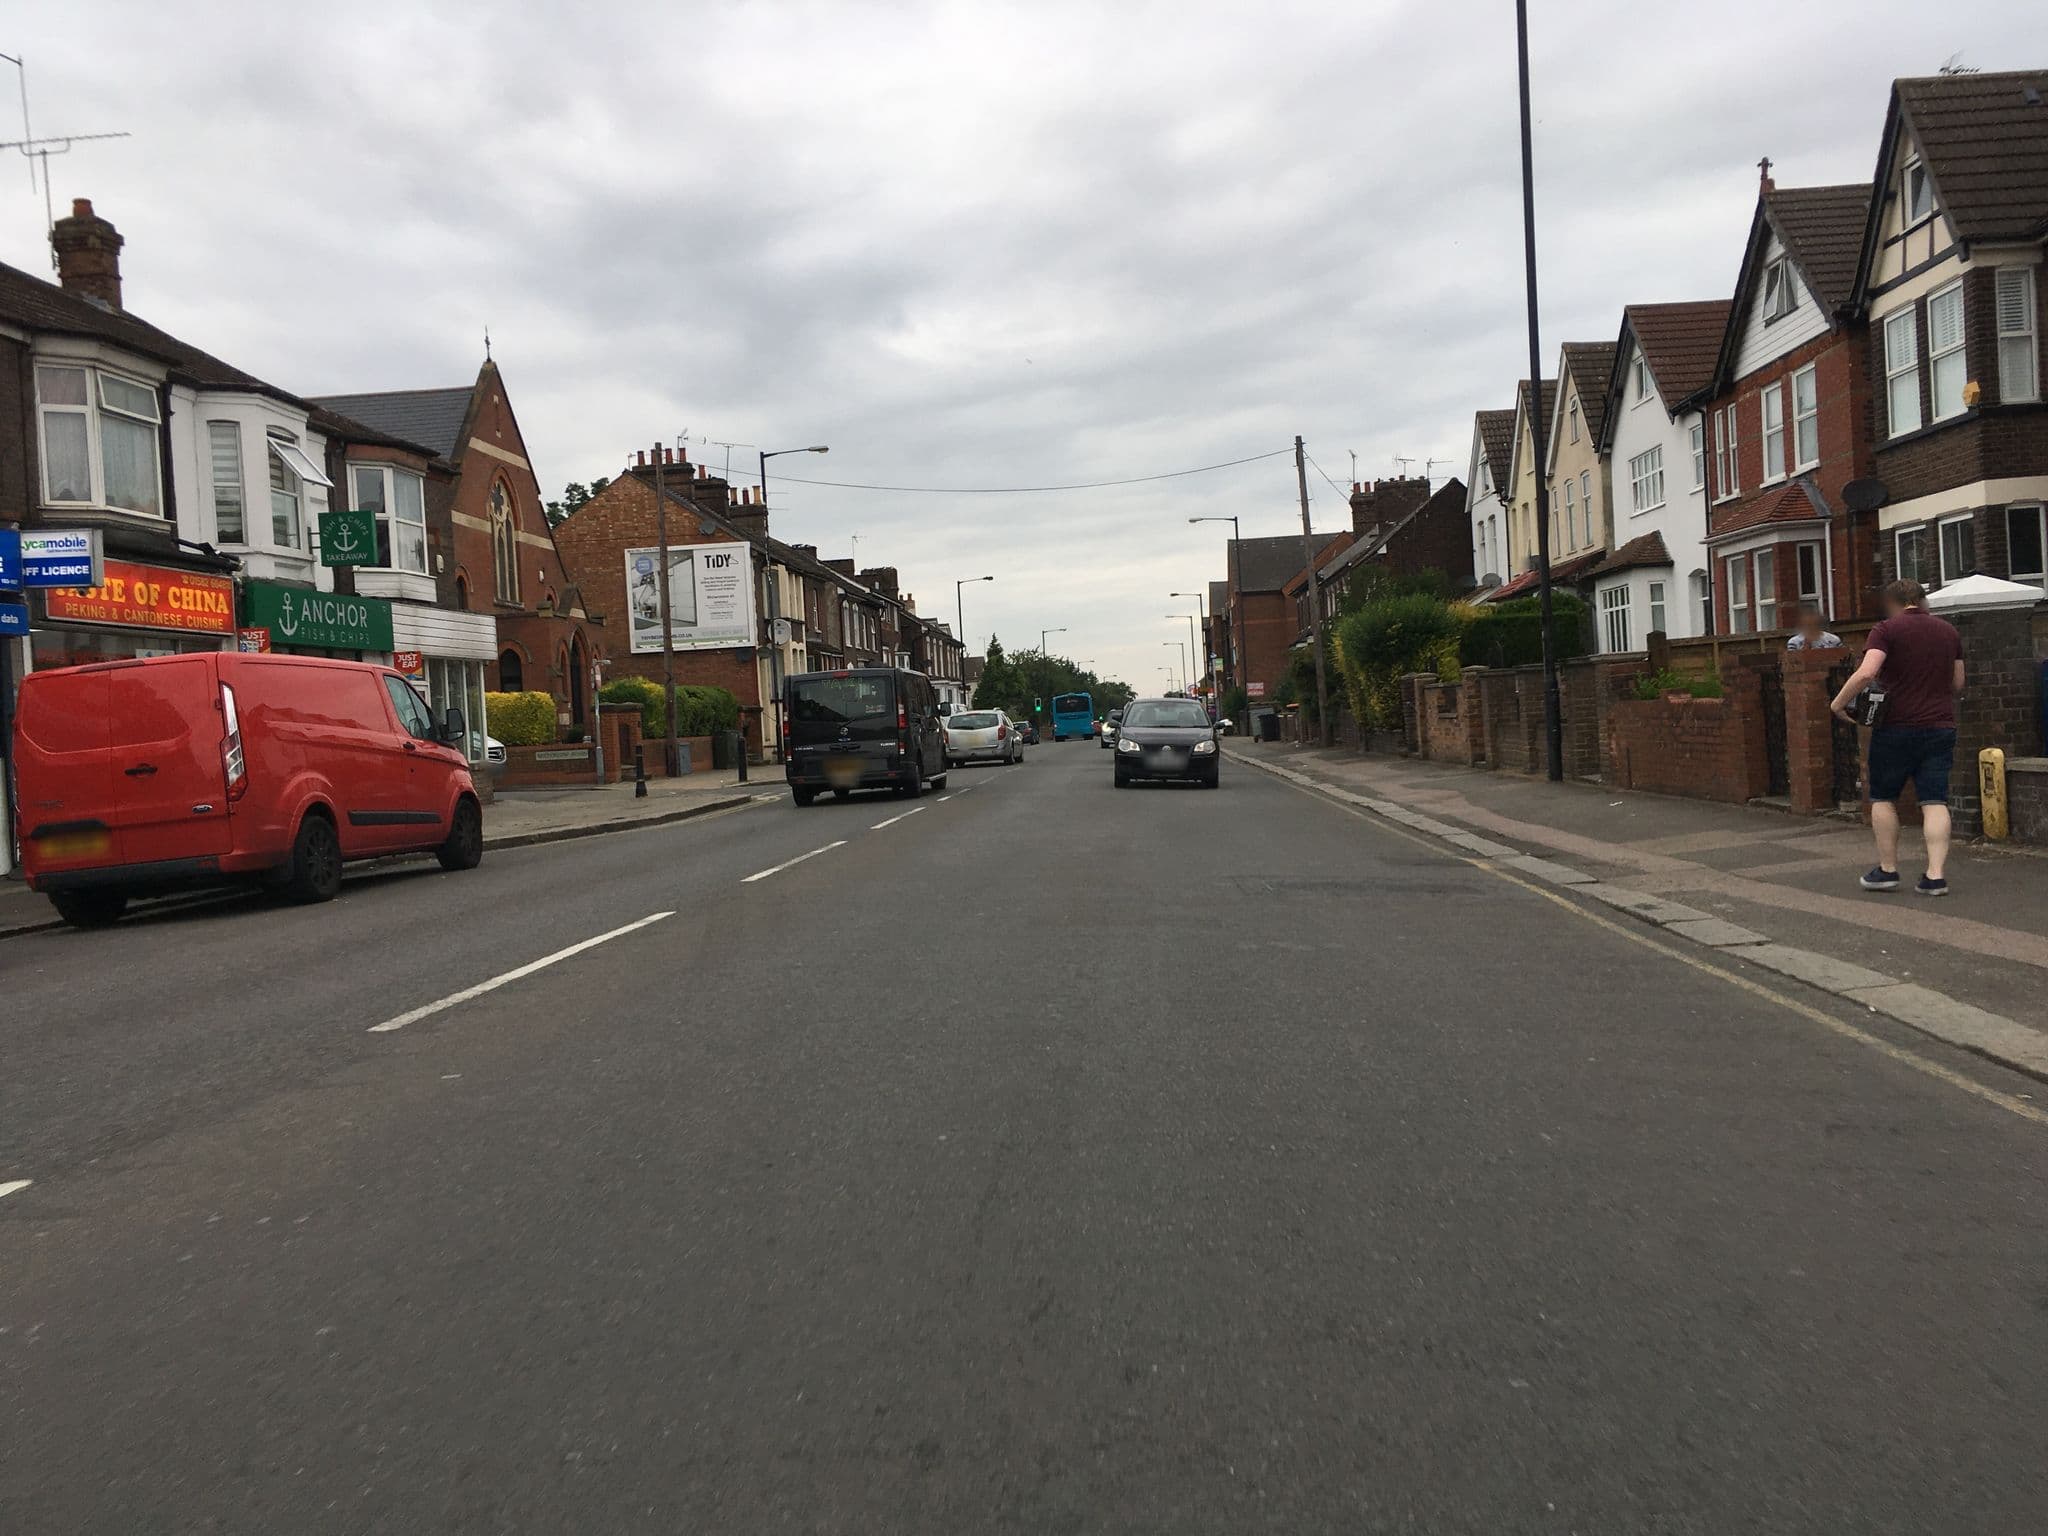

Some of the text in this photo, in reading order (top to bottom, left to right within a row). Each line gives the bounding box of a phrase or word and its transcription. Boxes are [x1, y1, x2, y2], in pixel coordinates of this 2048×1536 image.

[21, 537, 87, 551] ycamobile
[326, 552, 368, 561] TAKEAWAY
[42, 565, 90, 576] LICENCE
[134, 582, 161, 607] OF
[168, 586, 229, 615] CHINA
[65, 602, 224, 630] PEKING & CANTONESE CUISINE
[301, 598, 368, 628] ANCHOR
[301, 626, 326, 641] FISH
[340, 630, 370, 645] CHIPS
[397, 653, 418, 663] JUST
[402, 660, 418, 668] EAT
